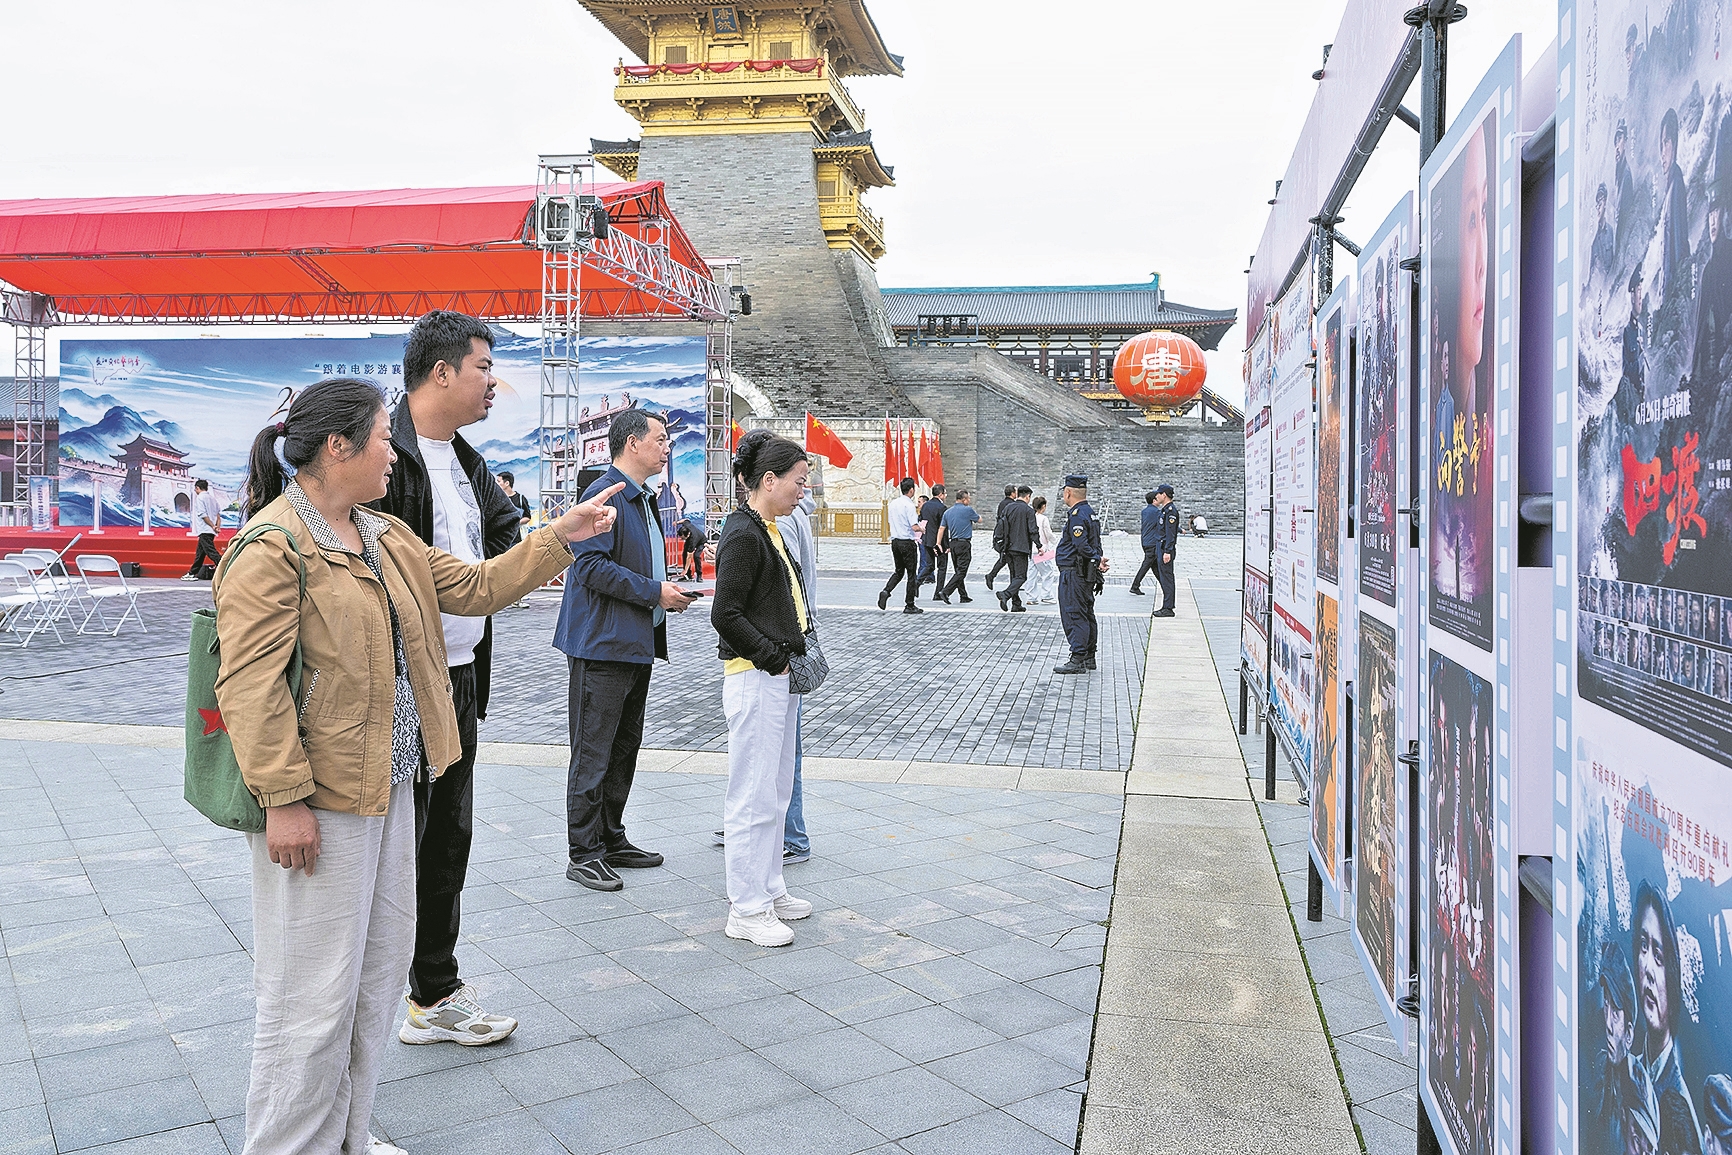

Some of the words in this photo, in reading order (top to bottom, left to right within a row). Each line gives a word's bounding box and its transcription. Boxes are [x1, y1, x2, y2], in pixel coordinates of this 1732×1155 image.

[1129, 346, 1192, 391] 唐
[1635, 398, 1661, 425] 6月26日
[1621, 431, 1707, 566] 四渡
[1592, 760, 1730, 868] 庆祝中华人民共和国成立70周年重点献礼
[1613, 797, 1715, 888] 纪念古田会议胜利召开90周年
